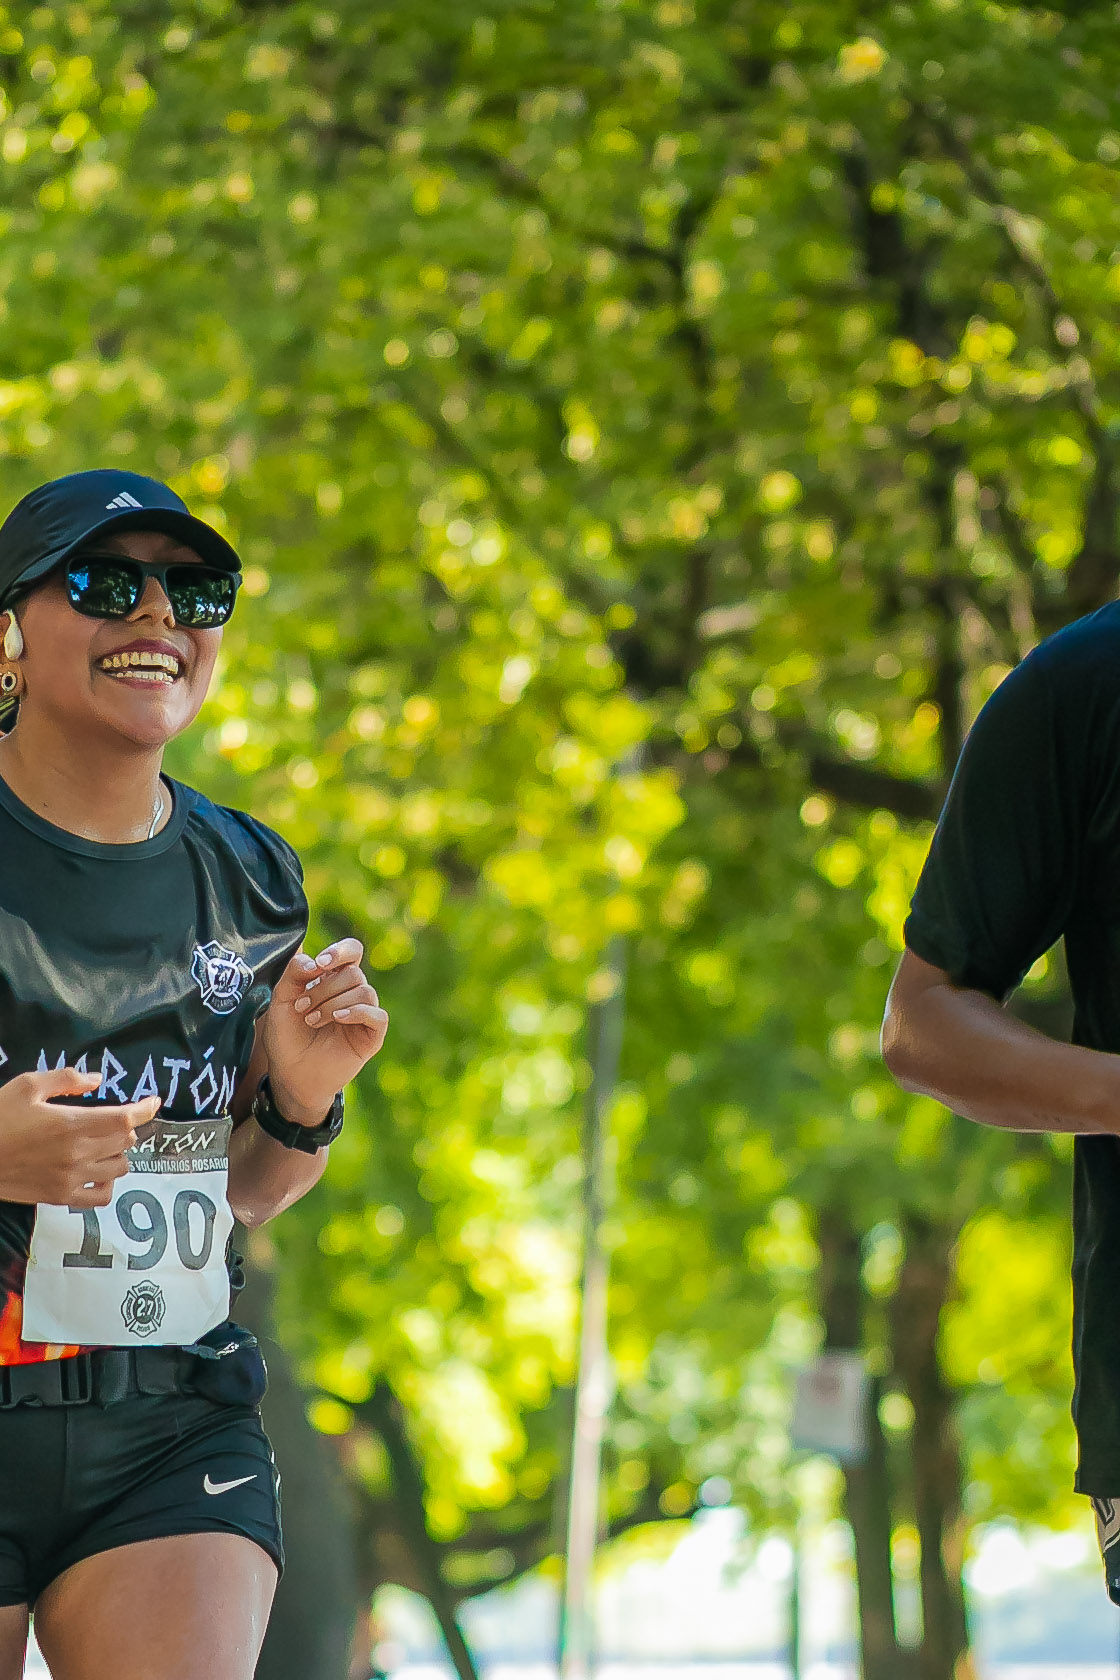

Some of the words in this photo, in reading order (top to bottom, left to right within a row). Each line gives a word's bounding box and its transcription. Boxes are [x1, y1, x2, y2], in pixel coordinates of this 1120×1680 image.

[124, 1126, 216, 1154] ATÓN
[135, 1158, 190, 1173] VOLUNTARIOS
[191, 1157, 228, 1172] ROSARIO
[63, 1189, 217, 1270] 190
